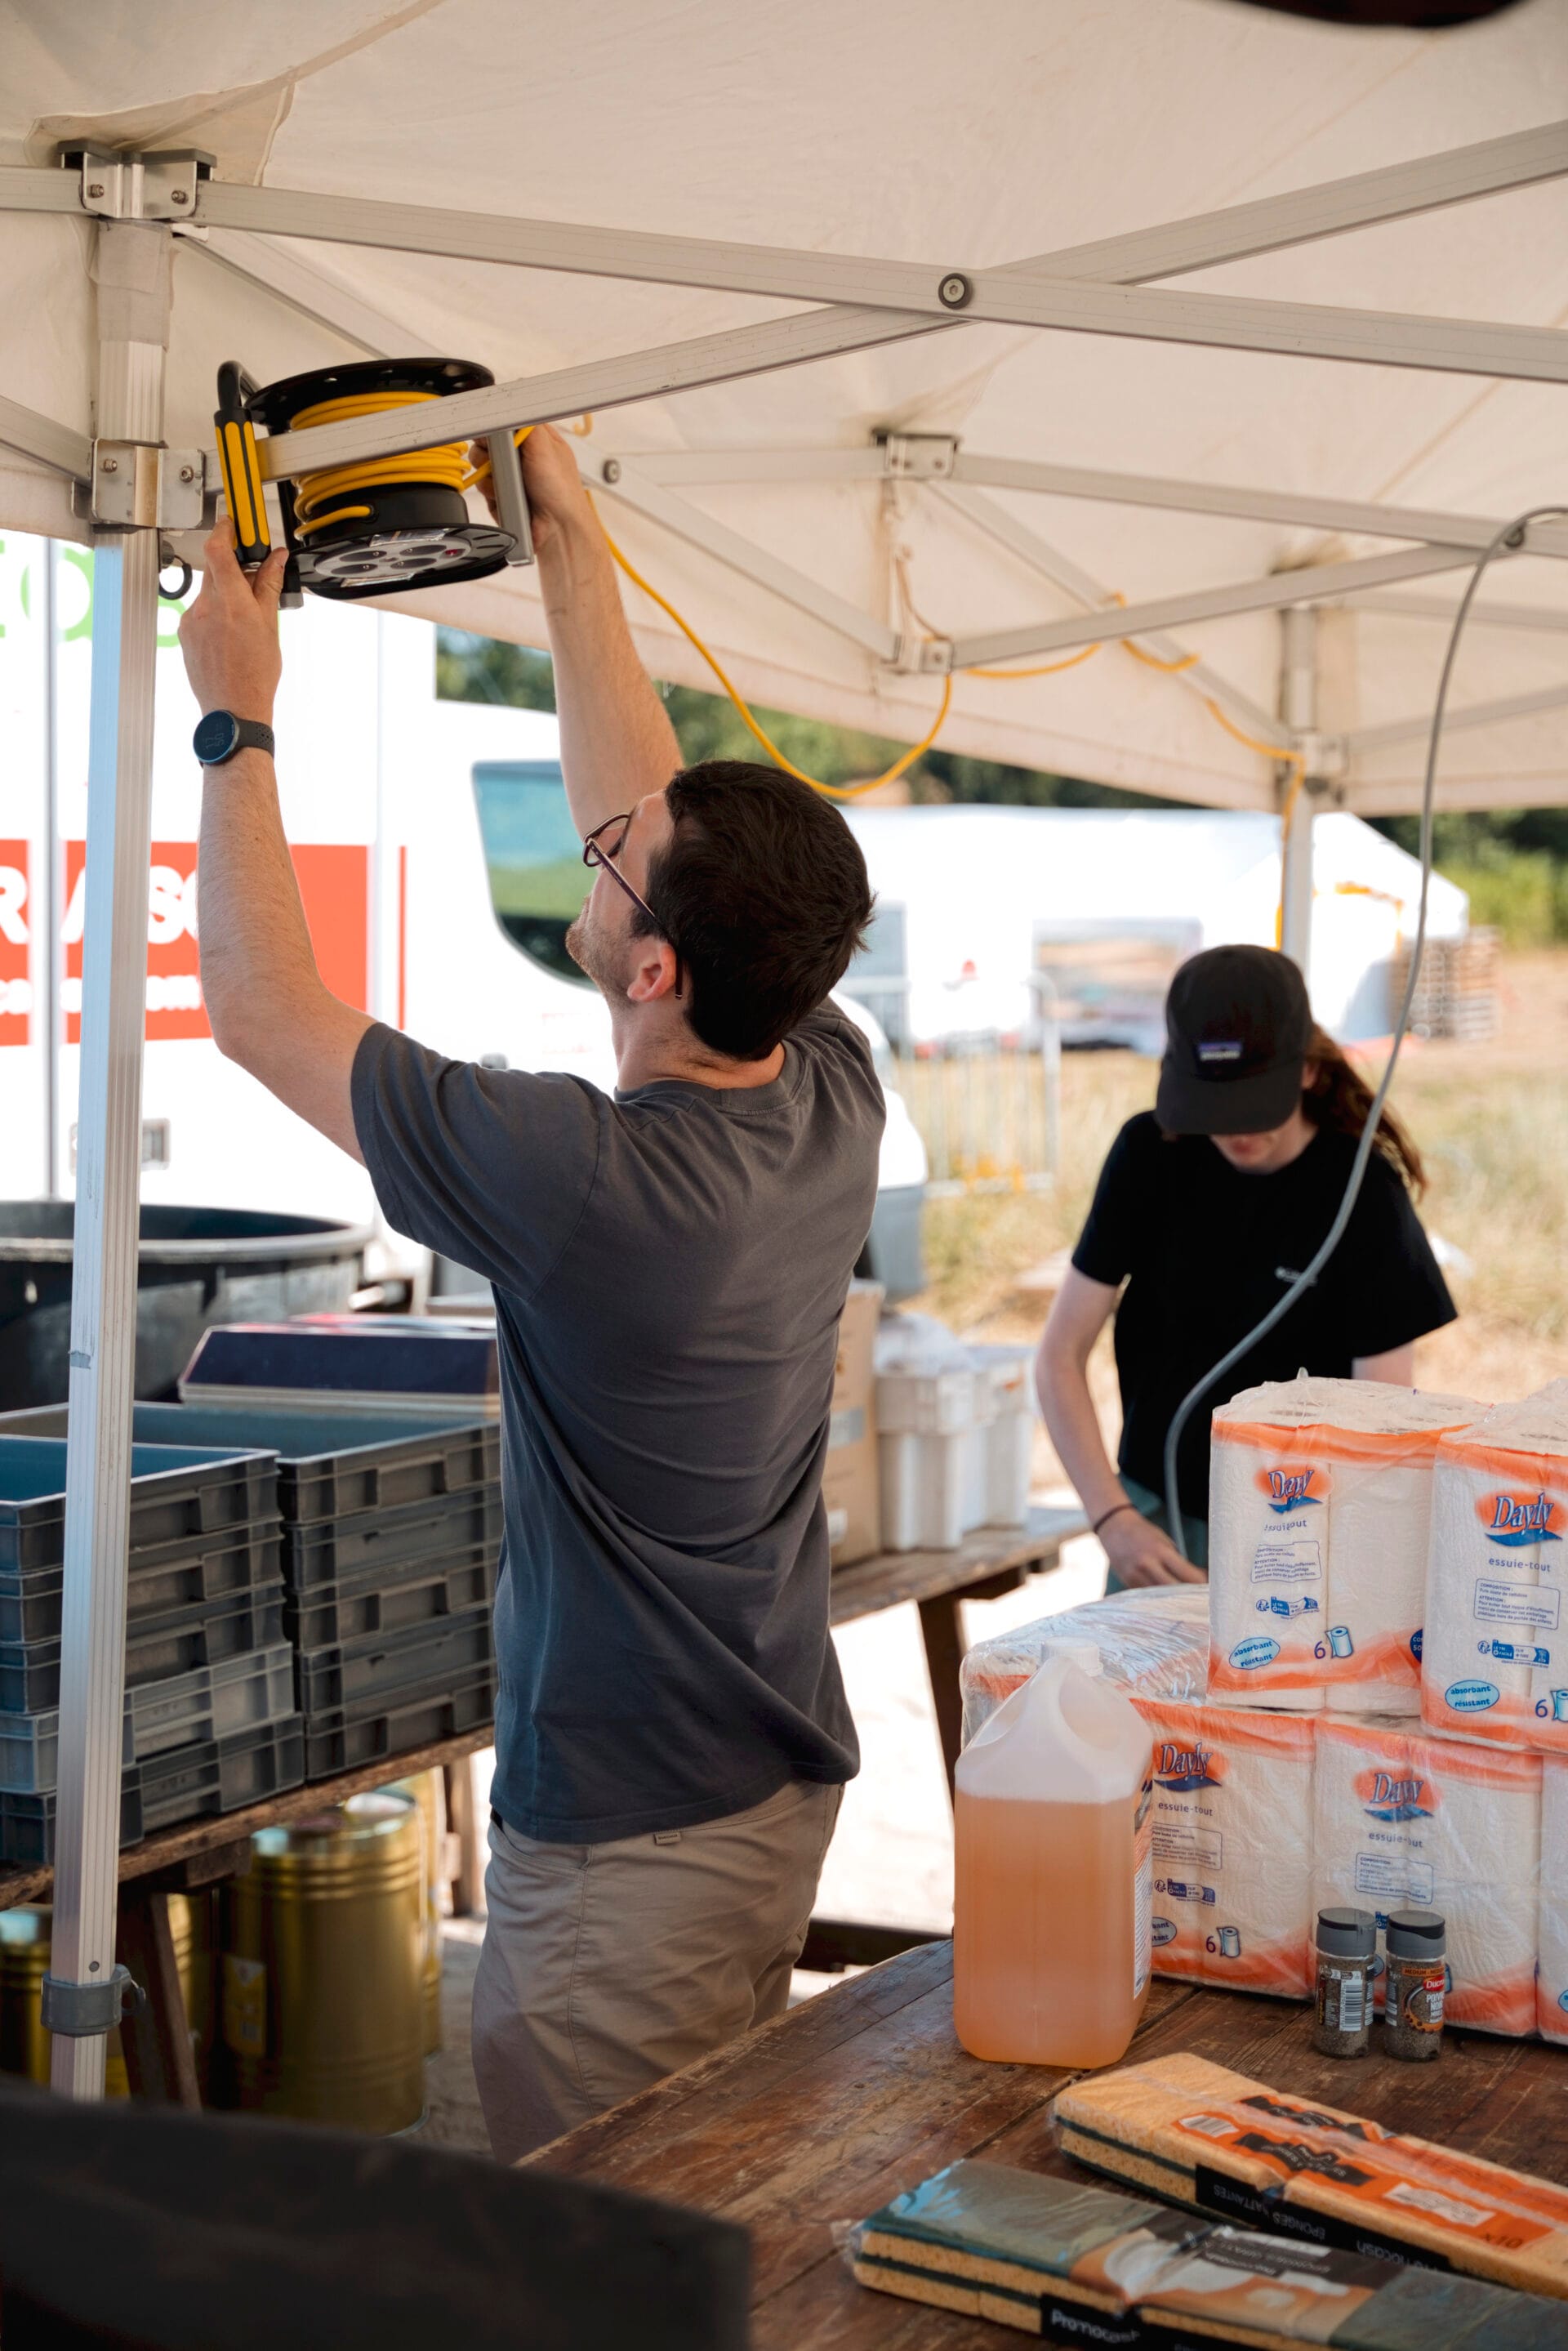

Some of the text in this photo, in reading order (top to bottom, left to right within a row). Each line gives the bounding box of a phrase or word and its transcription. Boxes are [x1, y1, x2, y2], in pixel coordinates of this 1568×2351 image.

[1490, 1492, 1554, 1536] Dayly
[1489, 1558, 1551, 1573] essuie-tout
[1314, 1640, 1326, 1660] 6
[1450, 1685, 1491, 1695] absorbant
[1454, 1698, 1490, 1707] résistant
[1535, 1698, 1548, 1718] 6
[1158, 1741, 1214, 1781] Dayly
[1158, 1802, 1214, 1816] essuie-tout
[1205, 1936, 1216, 1953] 6
[1272, 2212, 1326, 2241] ÉPONGES
